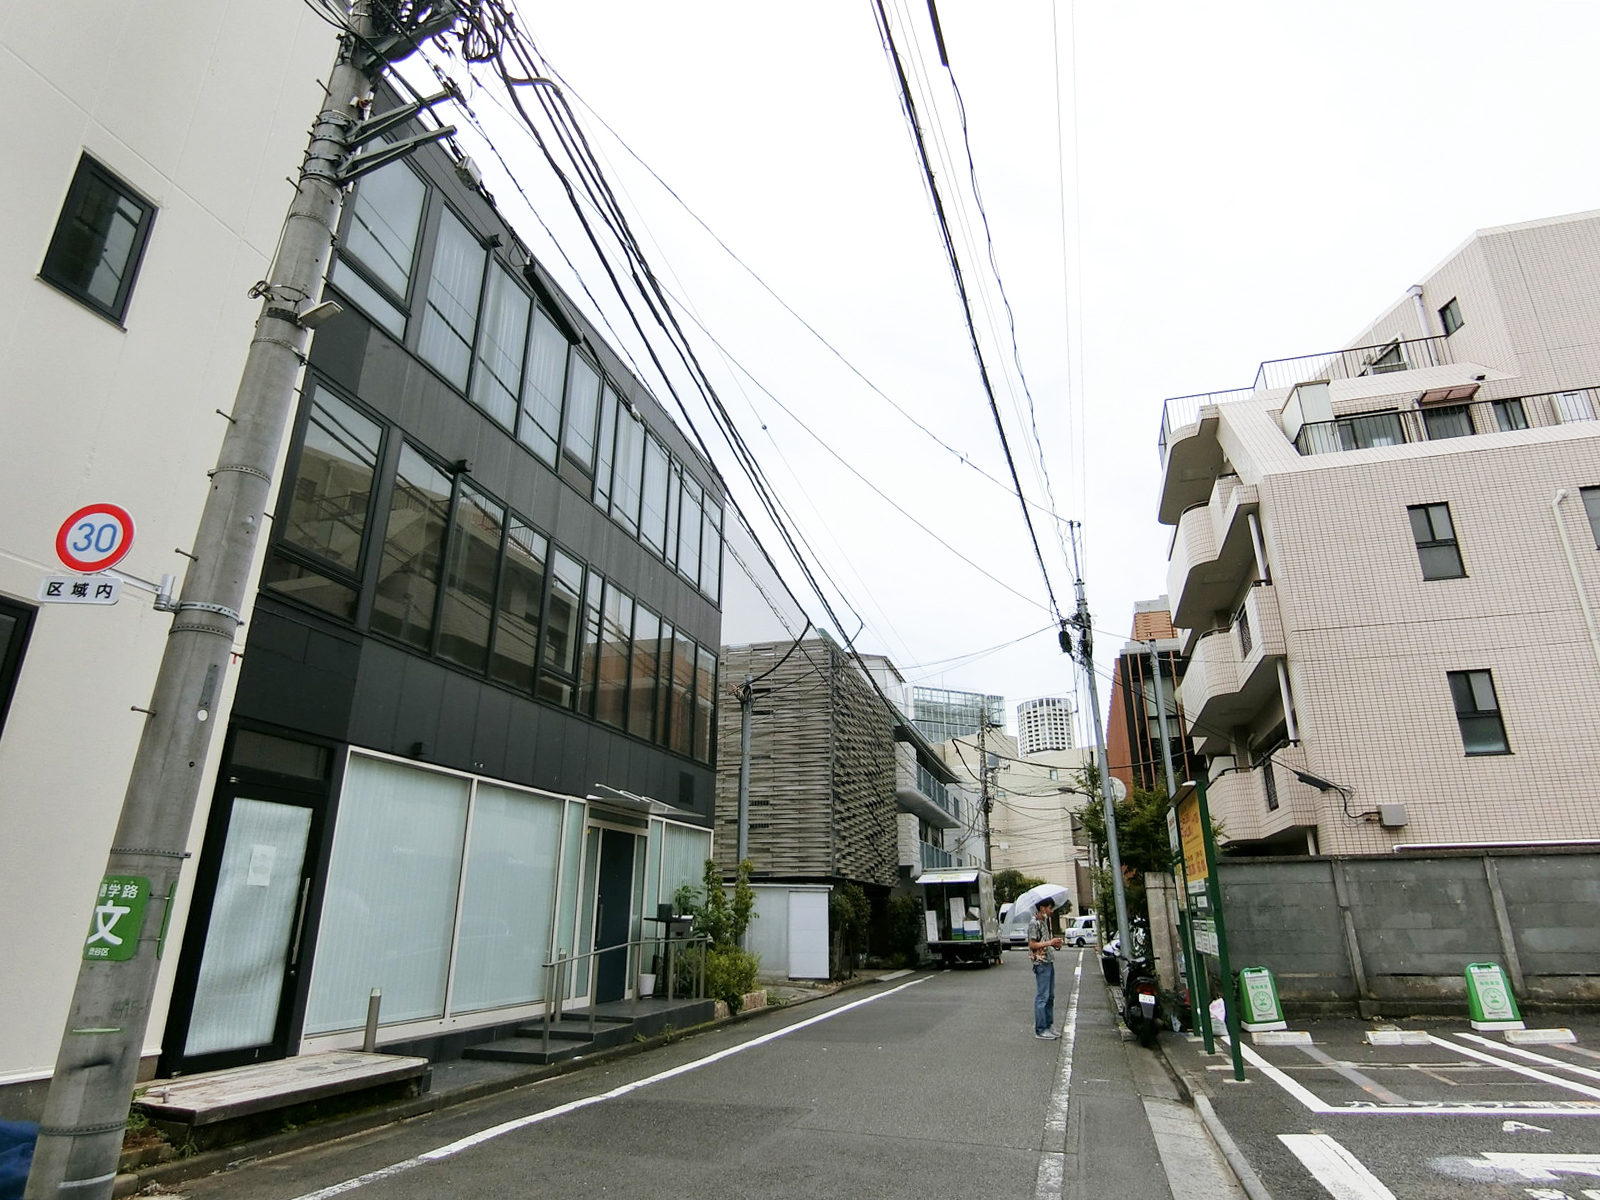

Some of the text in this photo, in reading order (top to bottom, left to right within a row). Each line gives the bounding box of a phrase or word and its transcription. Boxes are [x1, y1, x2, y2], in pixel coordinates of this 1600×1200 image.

[73, 522, 118, 553] 30
[46, 581, 114, 599] 区域内
[87, 899, 131, 945] 文
